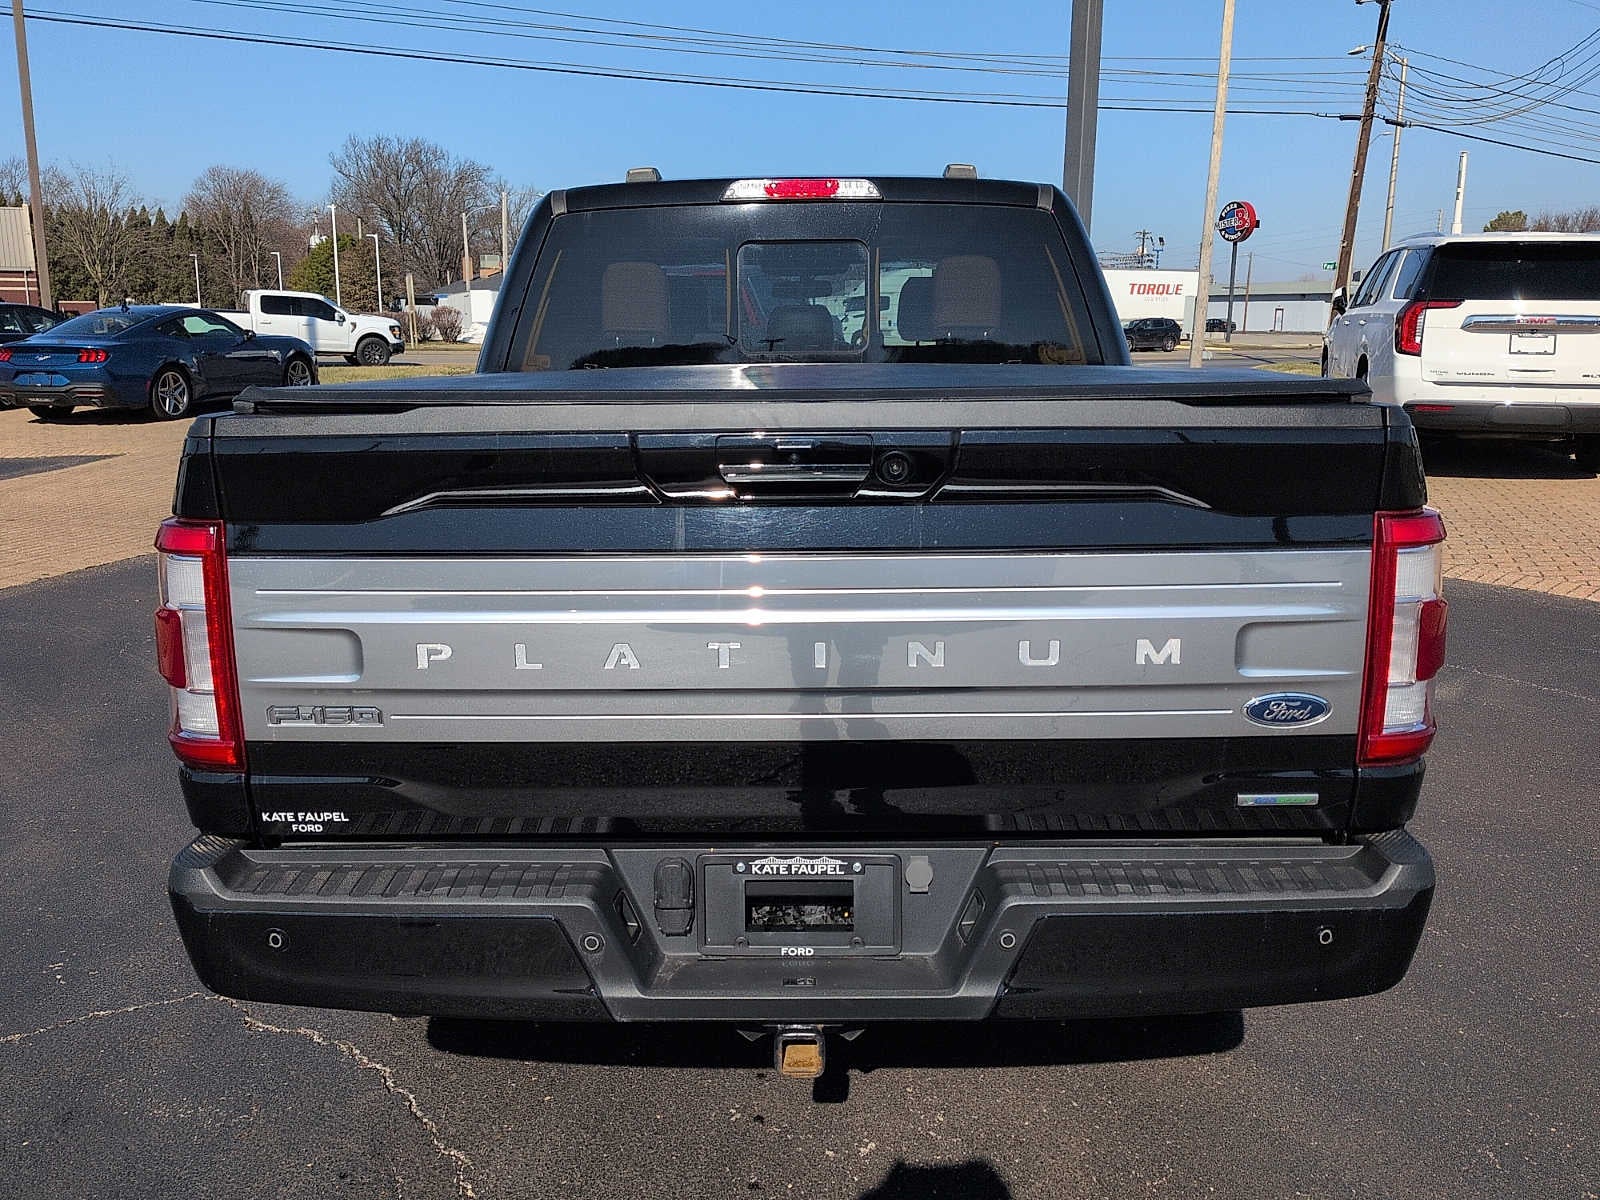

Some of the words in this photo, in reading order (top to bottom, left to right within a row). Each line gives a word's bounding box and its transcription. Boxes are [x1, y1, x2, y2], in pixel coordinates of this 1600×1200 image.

[1214, 217, 1238, 230] MISTER
[1129, 283, 1183, 295] TORQUE
[416, 638, 1181, 670] PLATINUM
[266, 705, 383, 727] F-150
[1264, 701, 1312, 719] Ford
[261, 812, 295, 822] KATE
[298, 812, 349, 822] FAUPEL
[292, 824, 323, 833] FORD
[751, 864, 788, 875] KATE
[791, 864, 845, 875] FAUPEL
[781, 947, 814, 956] FORD
